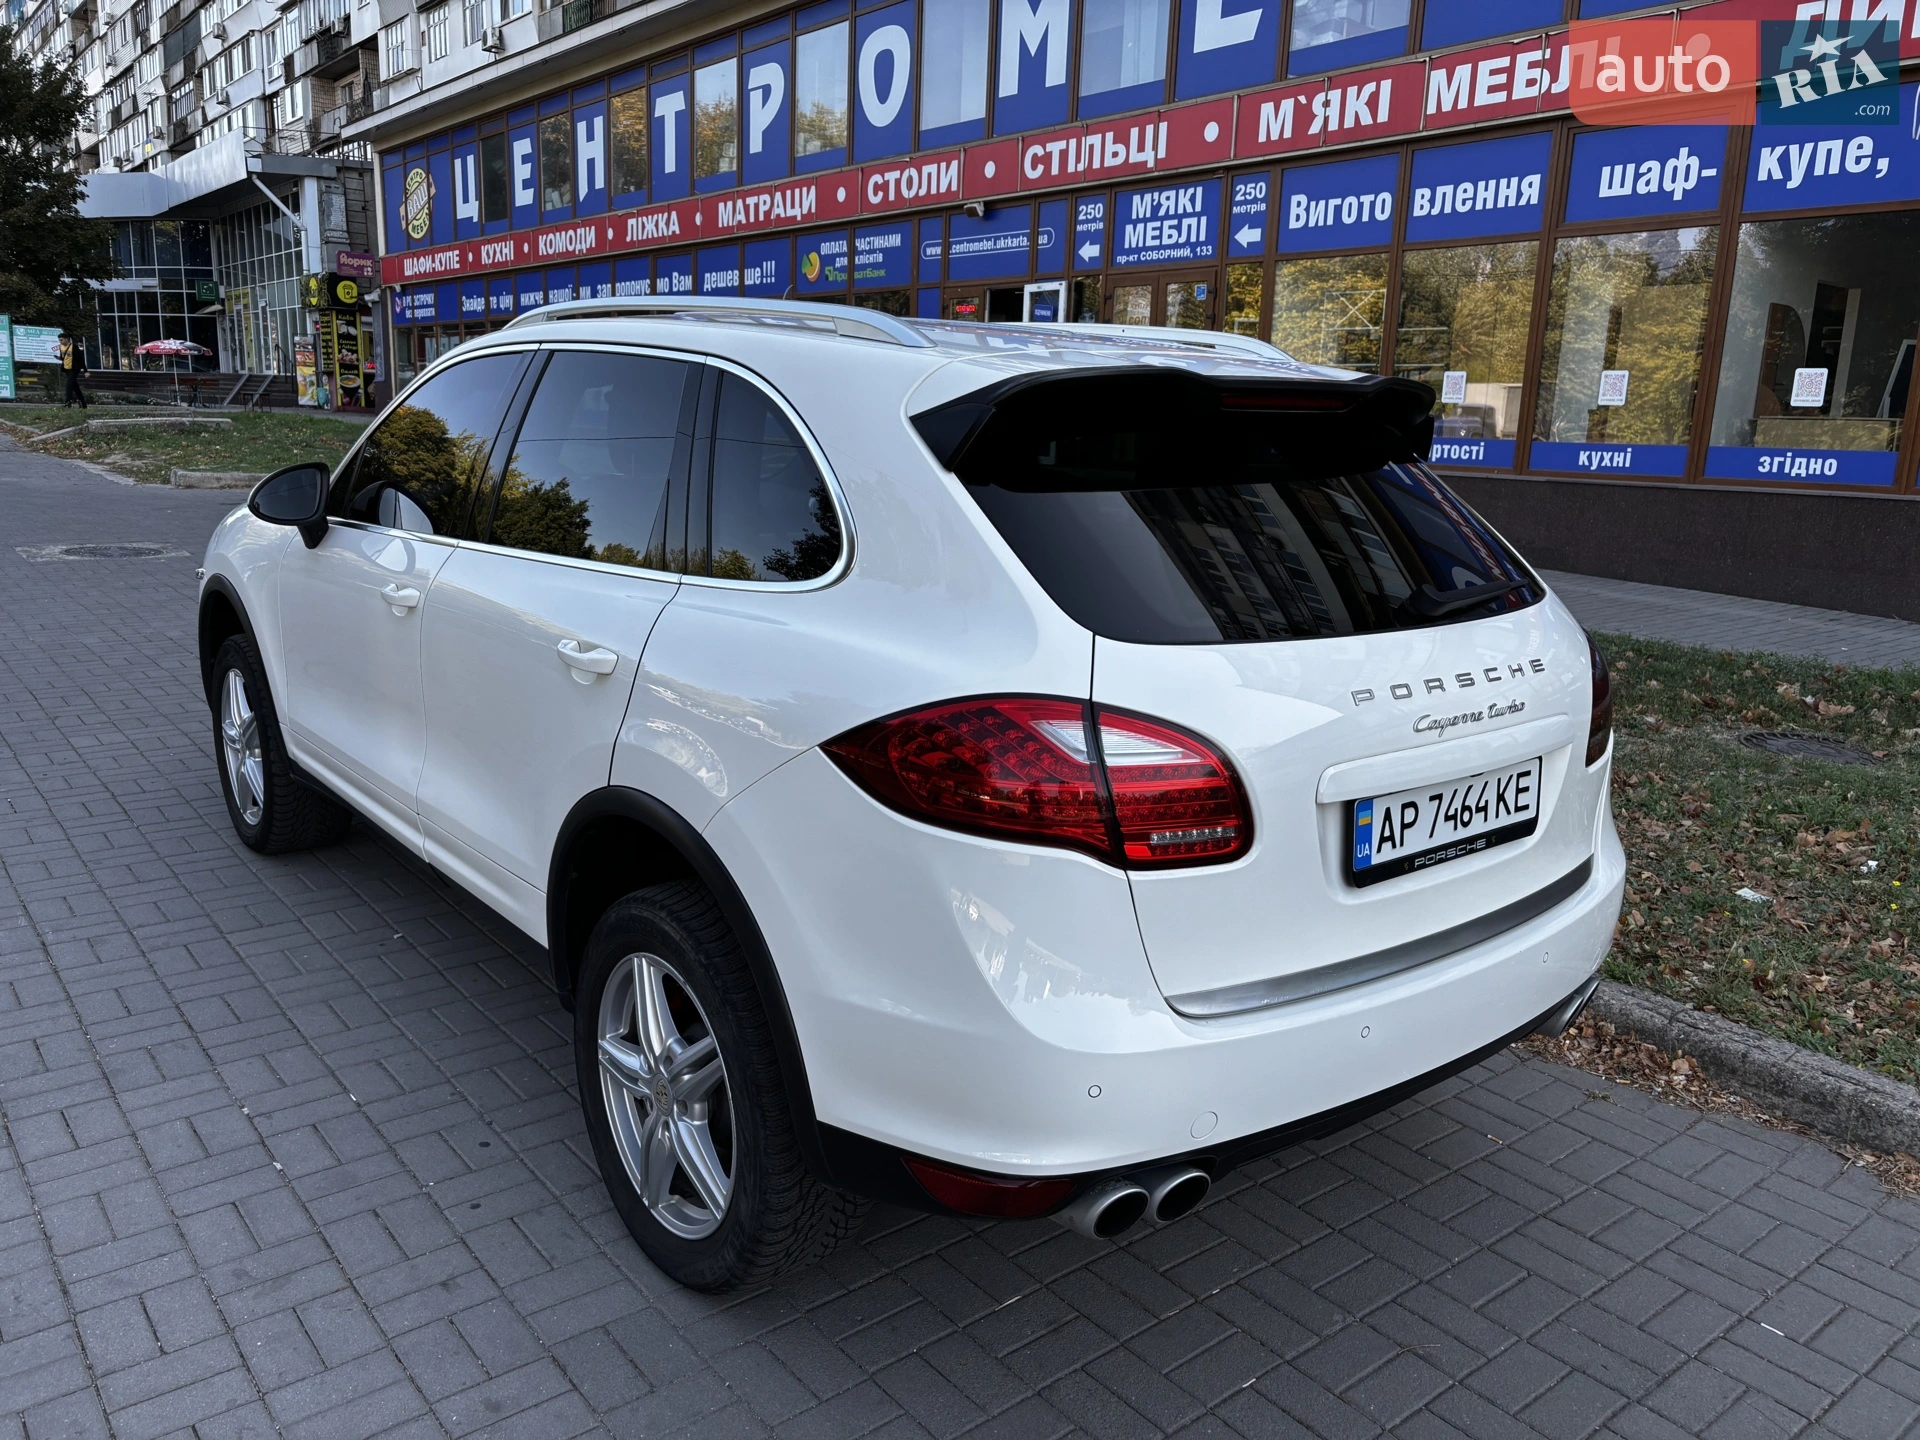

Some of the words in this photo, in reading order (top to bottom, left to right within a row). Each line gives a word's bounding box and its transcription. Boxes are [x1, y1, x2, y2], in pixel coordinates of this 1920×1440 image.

[1757, 136, 1890, 190] купе,
[404, 250, 460, 276] ШАФИ-КУПЕ
[481, 240, 514, 265] КУХНІ
[538, 226, 596, 257] КОМОДИ
[626, 211, 681, 242] ЛІЖКА
[718, 185, 817, 228] МАТРАЦИ
[867, 159, 959, 205] СТОЛИ
[1023, 121, 1168, 180] СТІЛЬЦІ
[1235, 181, 1267, 202] 250
[1078, 203, 1104, 221] 250
[1232, 202, 1267, 215] метрів
[1076, 221, 1104, 232] метрів
[1123, 215, 1208, 249] МЕБЛІ
[820, 240, 848, 255] ОПЛАТА
[855, 233, 901, 251] ЧАСТИНАМИ
[1116, 254, 1139, 265] пр-кт
[1140, 246, 1194, 261] СОБОРНИЙ,
[1195, 245, 1213, 256] 133
[835, 257, 848, 268] для
[854, 251, 883, 265] клієнтів
[499, 291, 514, 311] ціну
[520, 291, 543, 306] нижче
[580, 286, 591, 300] ми
[672, 271, 692, 292] Вам
[1428, 441, 1486, 462] ртості
[1578, 446, 1632, 471] кухні
[1757, 453, 1838, 478] згідно
[1351, 657, 1547, 707] PORSCHE
[1412, 710, 1484, 738] Cayenne
[1376, 800, 1420, 854] AP
[1428, 780, 1490, 839] 7464
[1494, 769, 1533, 820] KE
[1357, 842, 1371, 858] UA
[1414, 838, 1487, 868] PORSCHE
